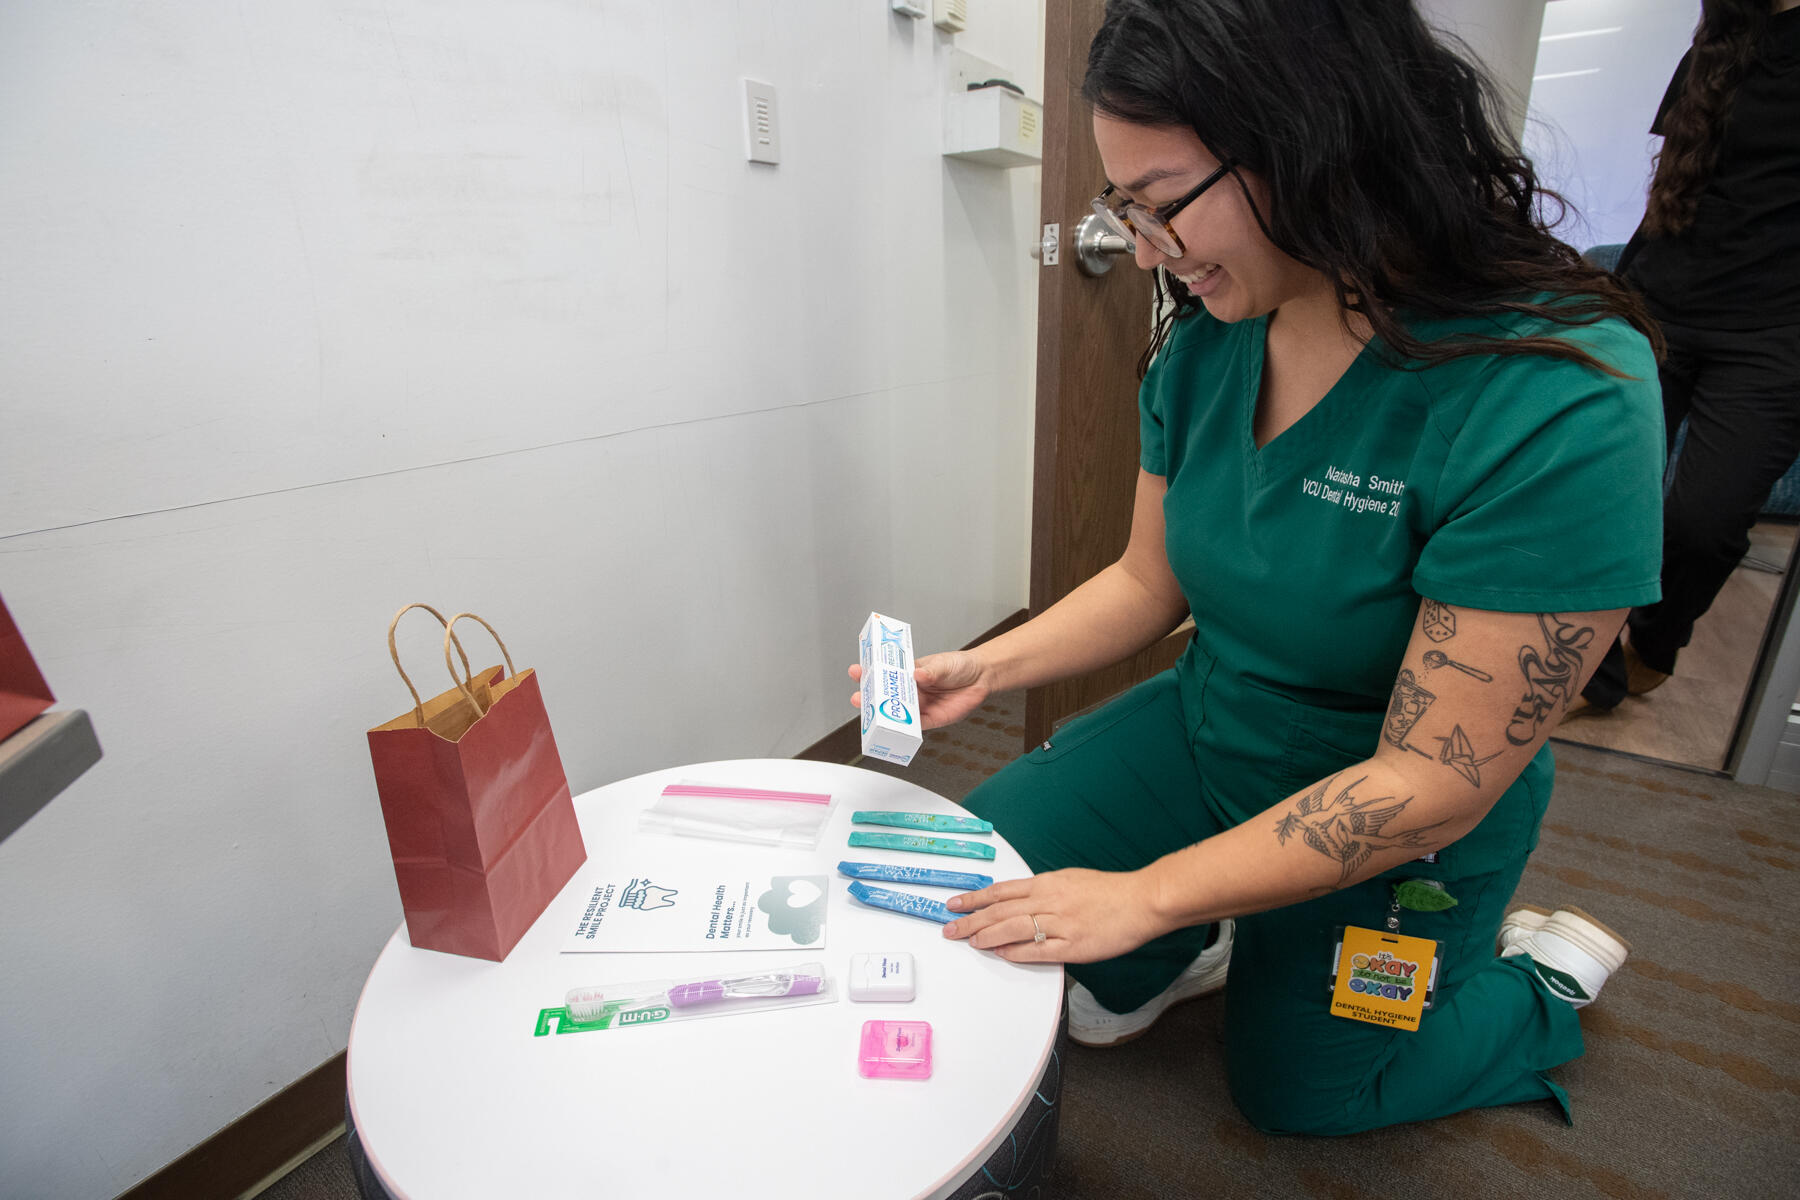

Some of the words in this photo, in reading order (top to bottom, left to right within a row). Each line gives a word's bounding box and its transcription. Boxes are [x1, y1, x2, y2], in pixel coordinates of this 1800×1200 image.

[1325, 465, 1360, 487] Natasha
[1368, 475, 1405, 496] Smith
[1302, 478, 1322, 497] VCU
[1321, 484, 1343, 504] Dental
[1343, 490, 1388, 513] Hygiene
[889, 670, 901, 719] PRONAMEL
[885, 869, 921, 878] WASH
[575, 922, 589, 936] THE
[582, 886, 604, 920] RESILIENT
[586, 918, 603, 939] SMILE
[596, 883, 616, 917] PROJECT
[712, 885, 726, 911] Health
[895, 899, 932, 913] WASH
[896, 892, 940, 908] MOUTH
[706, 911, 720, 939] Dental
[720, 901, 736, 939] Matters...
[1335, 1001, 1372, 1015] DENTAL
[1374, 1009, 1416, 1022] HYGIENE
[1352, 1011, 1397, 1024] STUDENT
